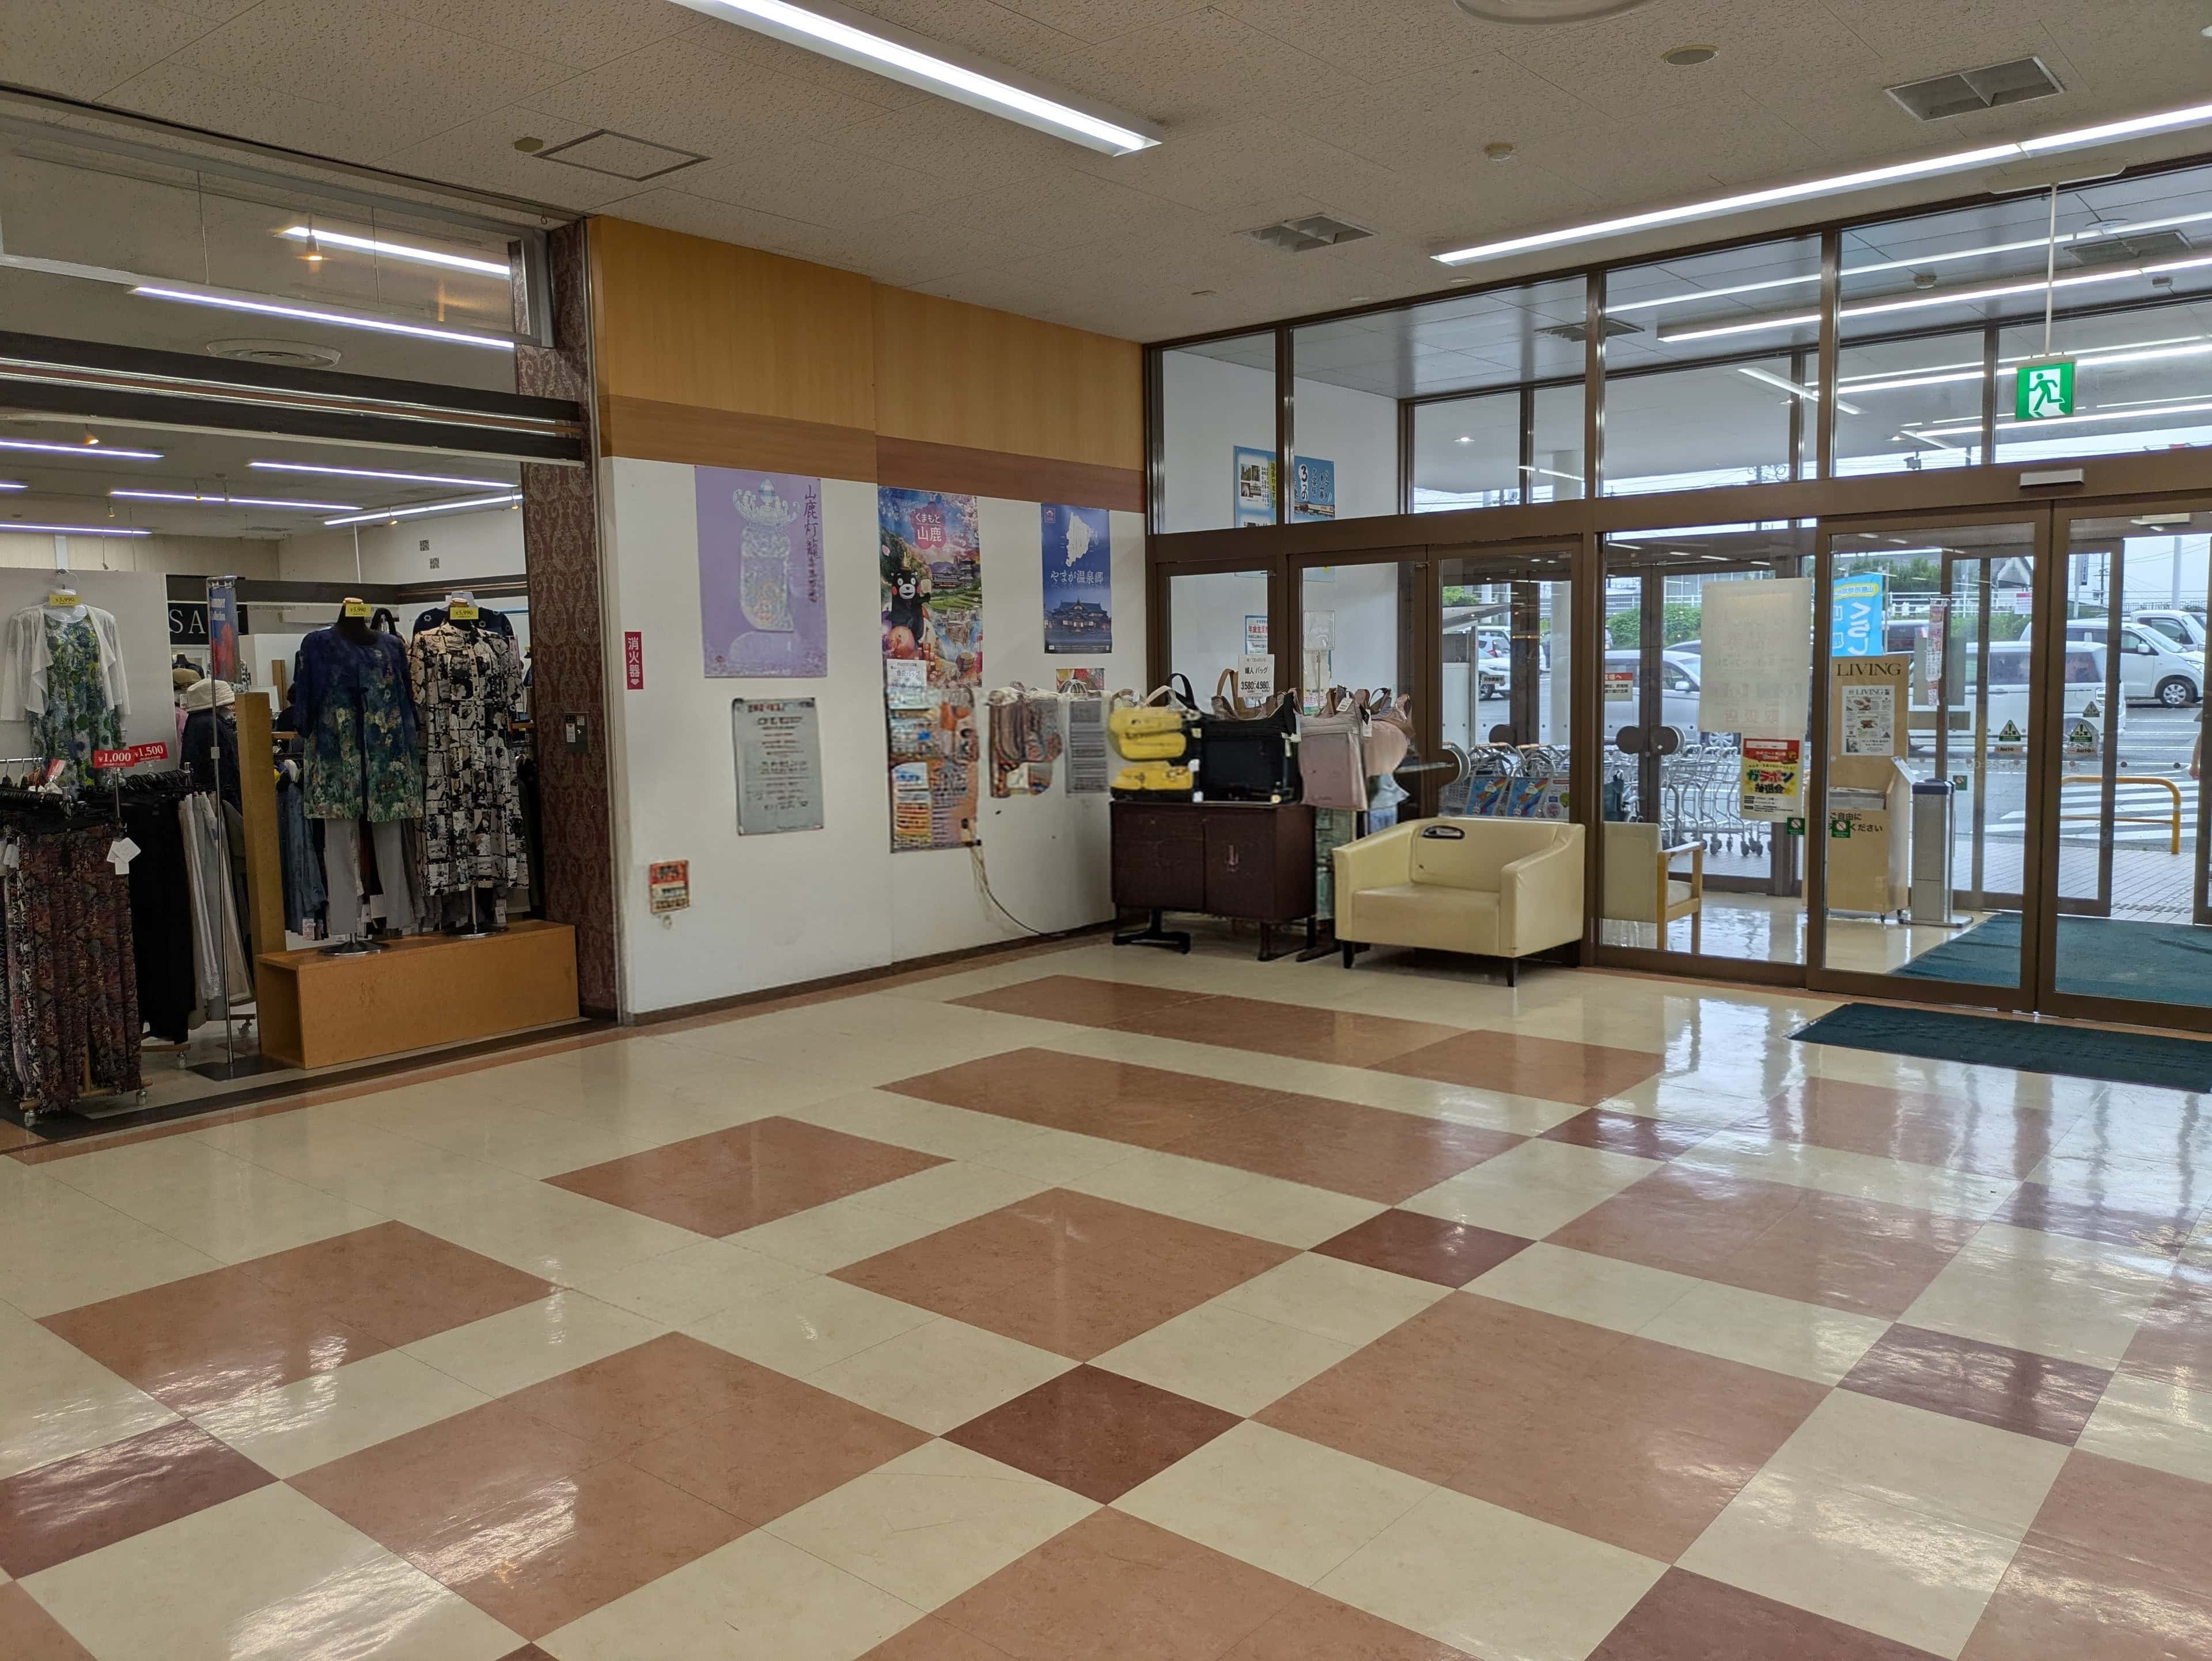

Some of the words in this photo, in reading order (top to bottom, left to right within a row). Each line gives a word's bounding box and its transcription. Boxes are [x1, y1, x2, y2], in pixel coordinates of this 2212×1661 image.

[916, 513, 941, 524] くまもと
[917, 526, 942, 542] 山鹿
[1050, 570, 1104, 584] やまが温泉郷
[628, 637, 640, 678] 消火器
[1836, 663, 1901, 676] LIVING
[135, 745, 164, 757] ¥1,500
[99, 752, 131, 763] ¥1,000
[1754, 783, 1785, 794] 抽選会
[1830, 812, 1862, 821] ご自由に
